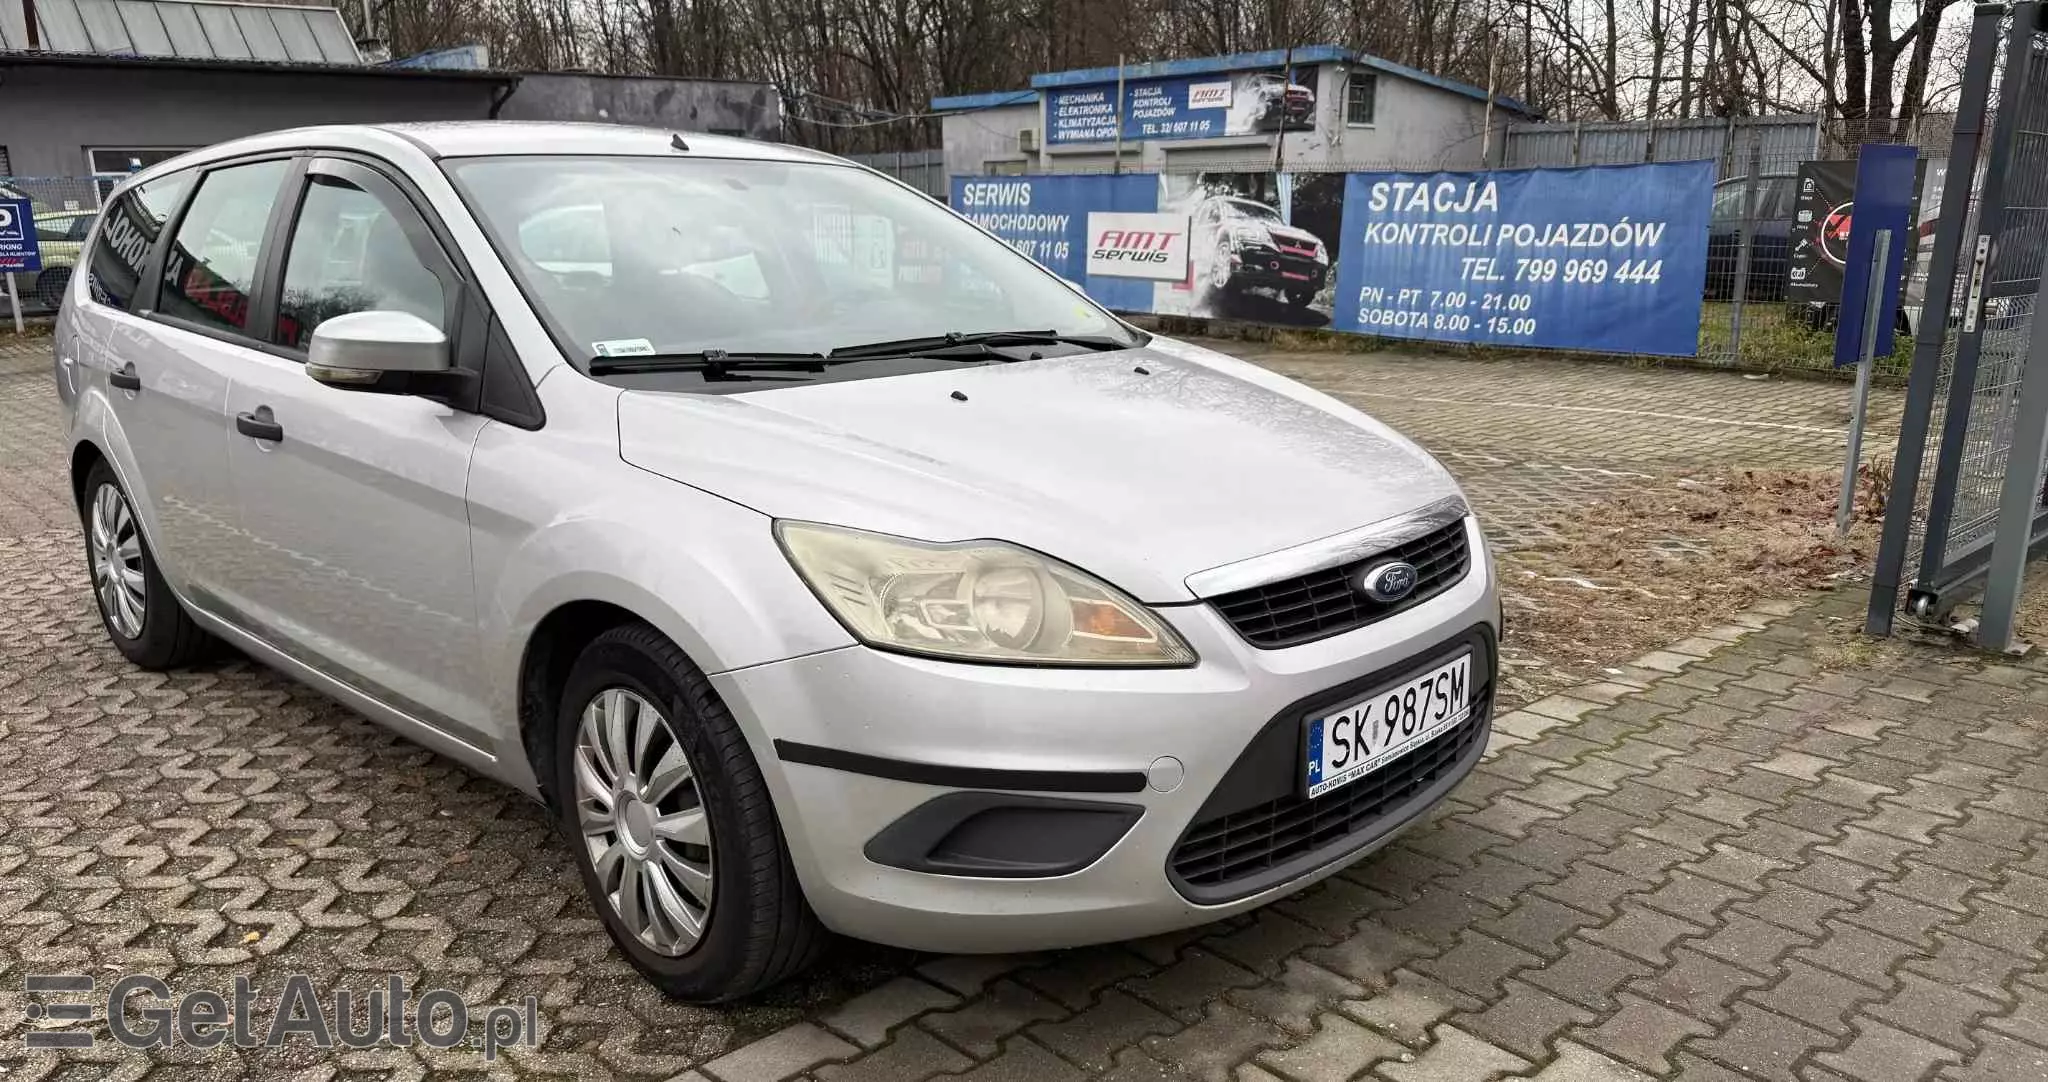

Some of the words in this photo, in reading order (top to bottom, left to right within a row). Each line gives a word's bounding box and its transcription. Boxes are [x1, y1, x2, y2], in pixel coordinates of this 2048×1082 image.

[1058, 92, 1105, 106] MECHANIKA
[1132, 97, 1172, 108] KONTROLI
[1133, 87, 1163, 98] STACJA
[1058, 103, 1114, 117] ELEKTRONIKA
[1058, 115, 1118, 128] KLIMATYZACJA
[1142, 124, 1159, 135] TEL.
[1174, 122, 1189, 134] 607
[1190, 122, 1198, 133] 11
[1057, 128, 1095, 140] WYMIANA
[963, 182, 1032, 206] SERWIS
[1367, 181, 1499, 213] STACJA
[1097, 230, 1182, 250] AMT
[1364, 222, 1490, 247] KONTROLI
[1495, 216, 1666, 247] POJAZDÓW
[1016, 239, 1036, 257] 607
[1039, 241, 1052, 258] 11
[1053, 241, 1070, 259] 05
[1091, 248, 1169, 263] serwis
[1460, 257, 1505, 281] TEL.
[1514, 258, 1558, 283] 799
[1562, 259, 1608, 284] 969
[1613, 259, 1663, 284] 444
[1359, 286, 1384, 303] PN
[1398, 288, 1422, 305] PT
[1430, 291, 1467, 309] 7.00
[1481, 293, 1531, 311] 21.00
[1358, 308, 1429, 329] SOBOTA
[1433, 314, 1470, 332] 8.00
[1487, 317, 1537, 335] 15.00
[1385, 569, 1409, 593] Ford
[1331, 704, 1372, 769] SK
[1384, 662, 1465, 747] 987SM
[1308, 760, 1320, 775] PL
